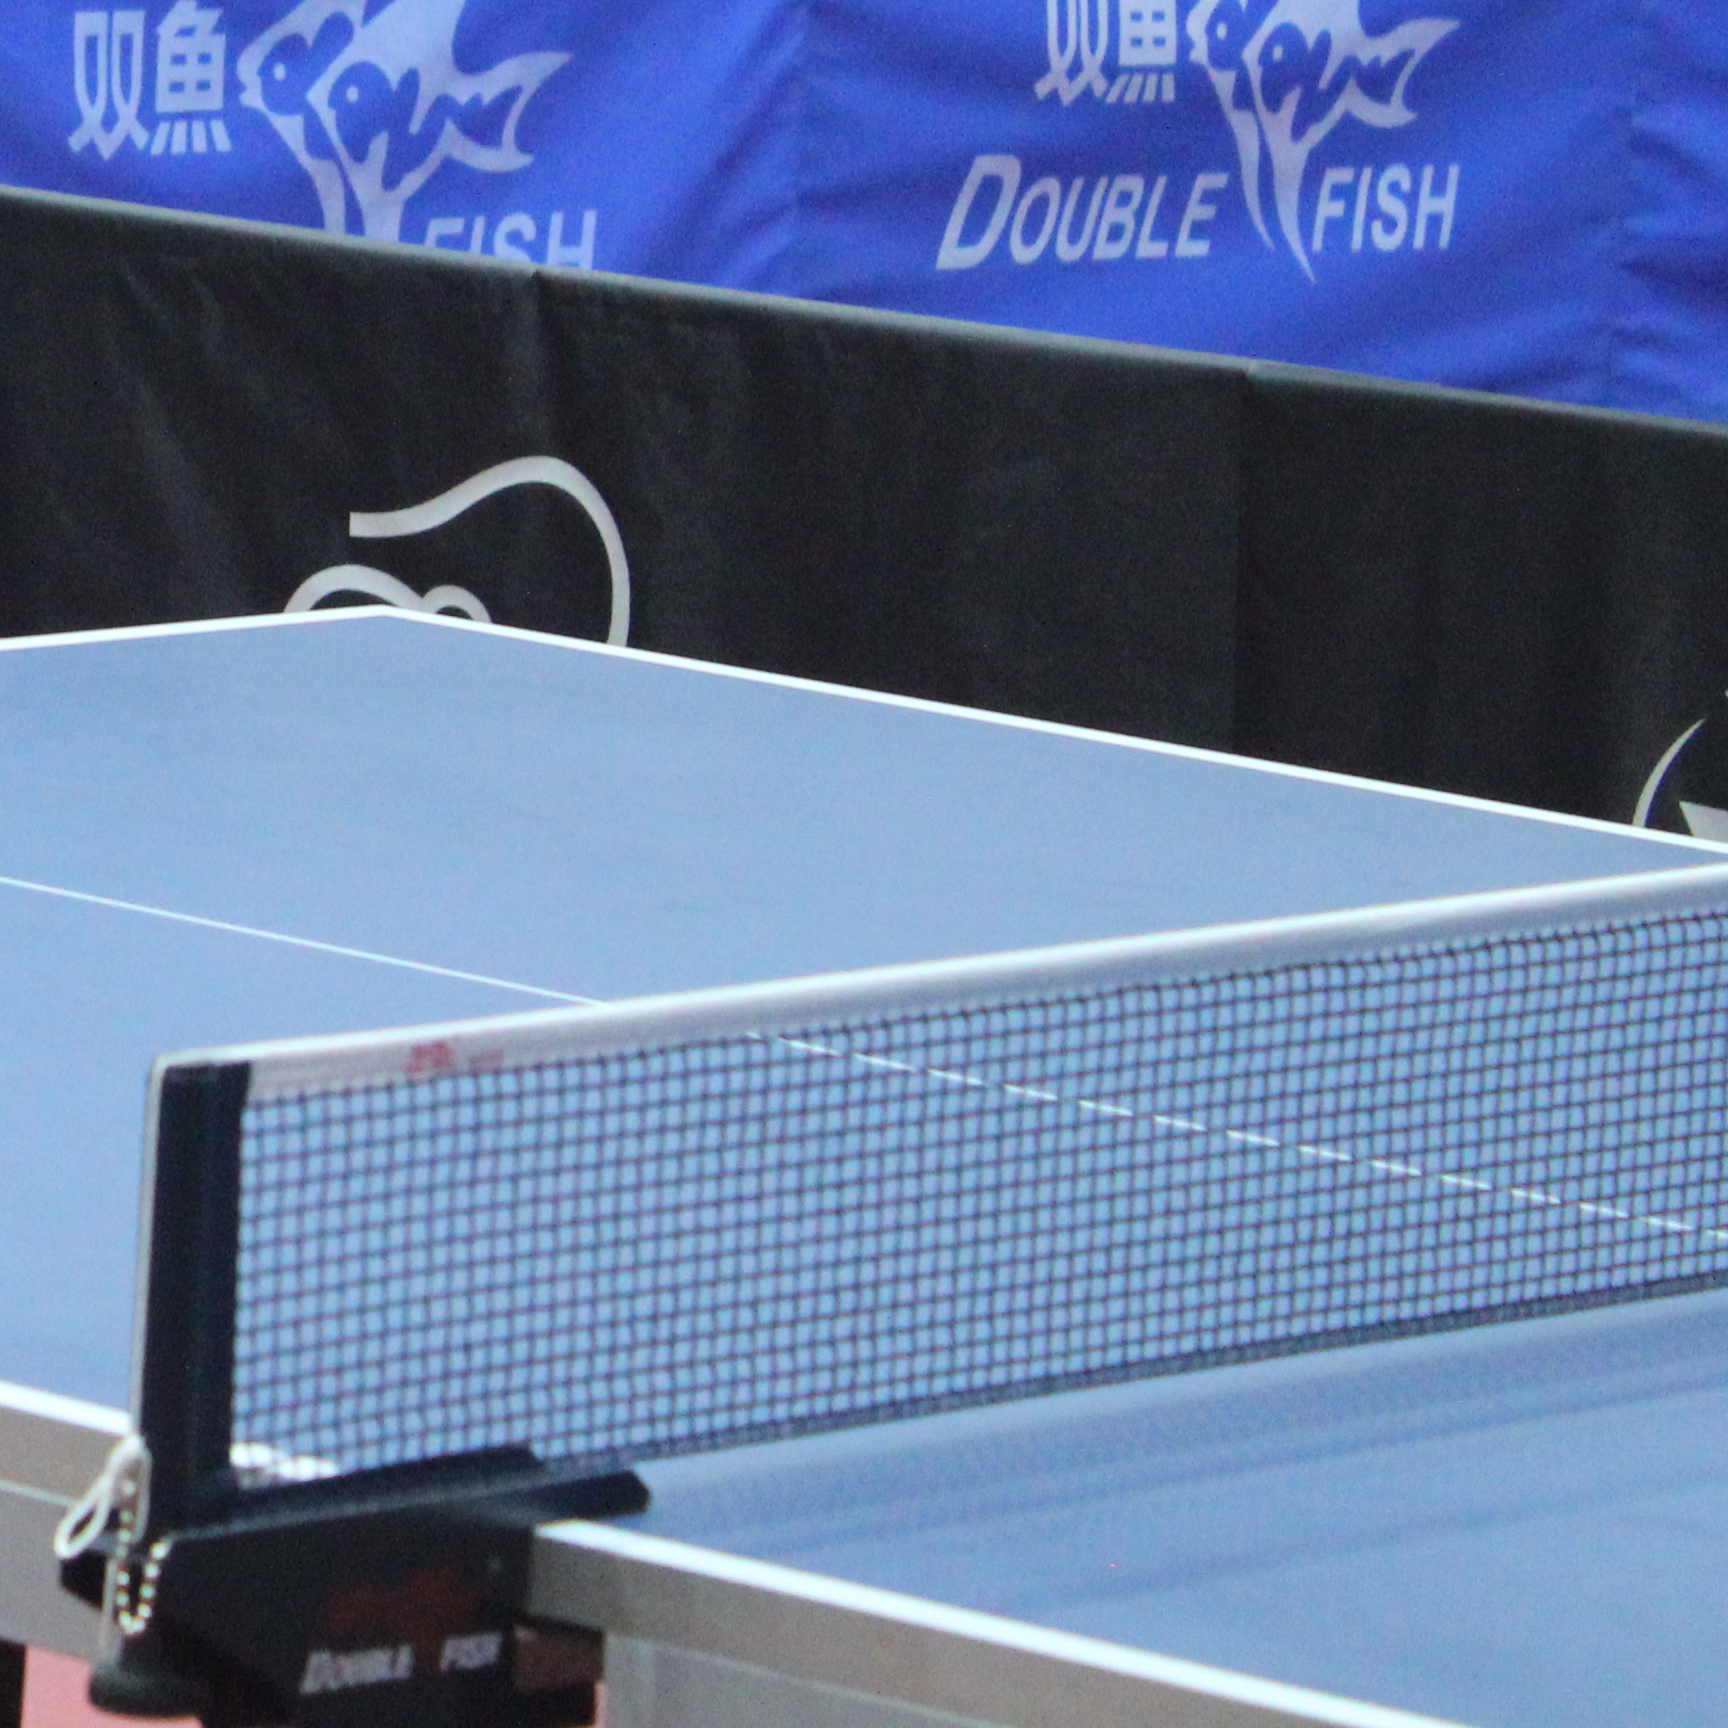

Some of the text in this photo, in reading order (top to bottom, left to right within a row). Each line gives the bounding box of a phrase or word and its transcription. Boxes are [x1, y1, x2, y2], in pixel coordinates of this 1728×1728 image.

[935, 154, 1460, 271] DOUBLE FISH
[439, 1631, 503, 1672] FISH
